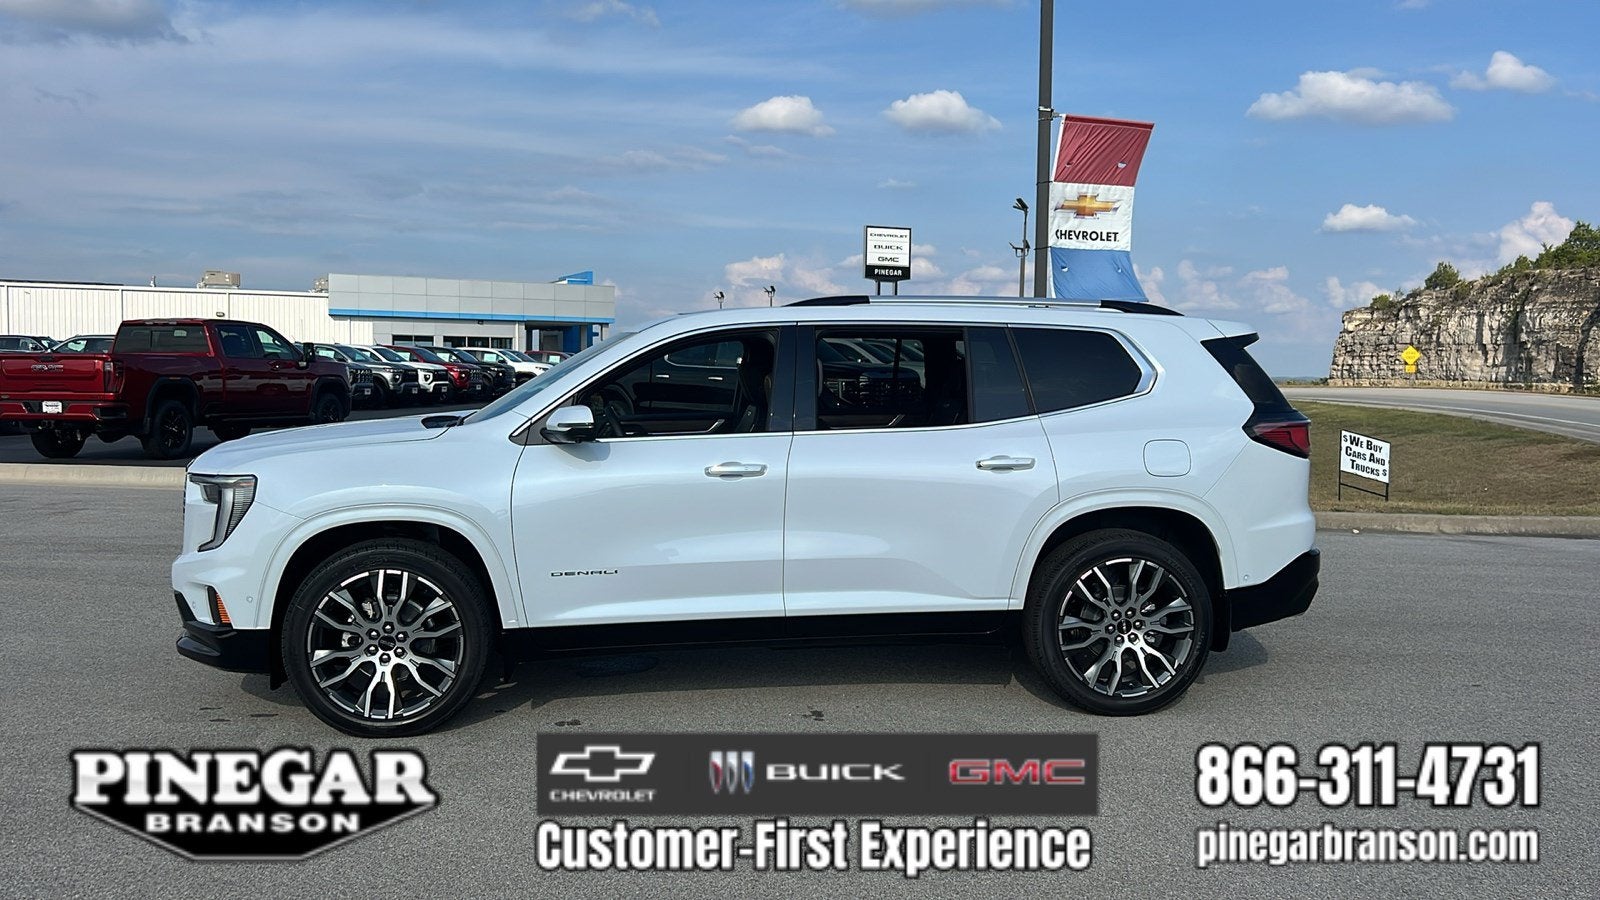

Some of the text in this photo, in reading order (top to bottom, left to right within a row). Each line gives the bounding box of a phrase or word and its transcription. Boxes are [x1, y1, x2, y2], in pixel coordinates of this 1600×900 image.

[1055, 228, 1120, 243] CHEVROLET
[874, 268, 903, 276] PINEGAR
[551, 569, 618, 577] DENALI
